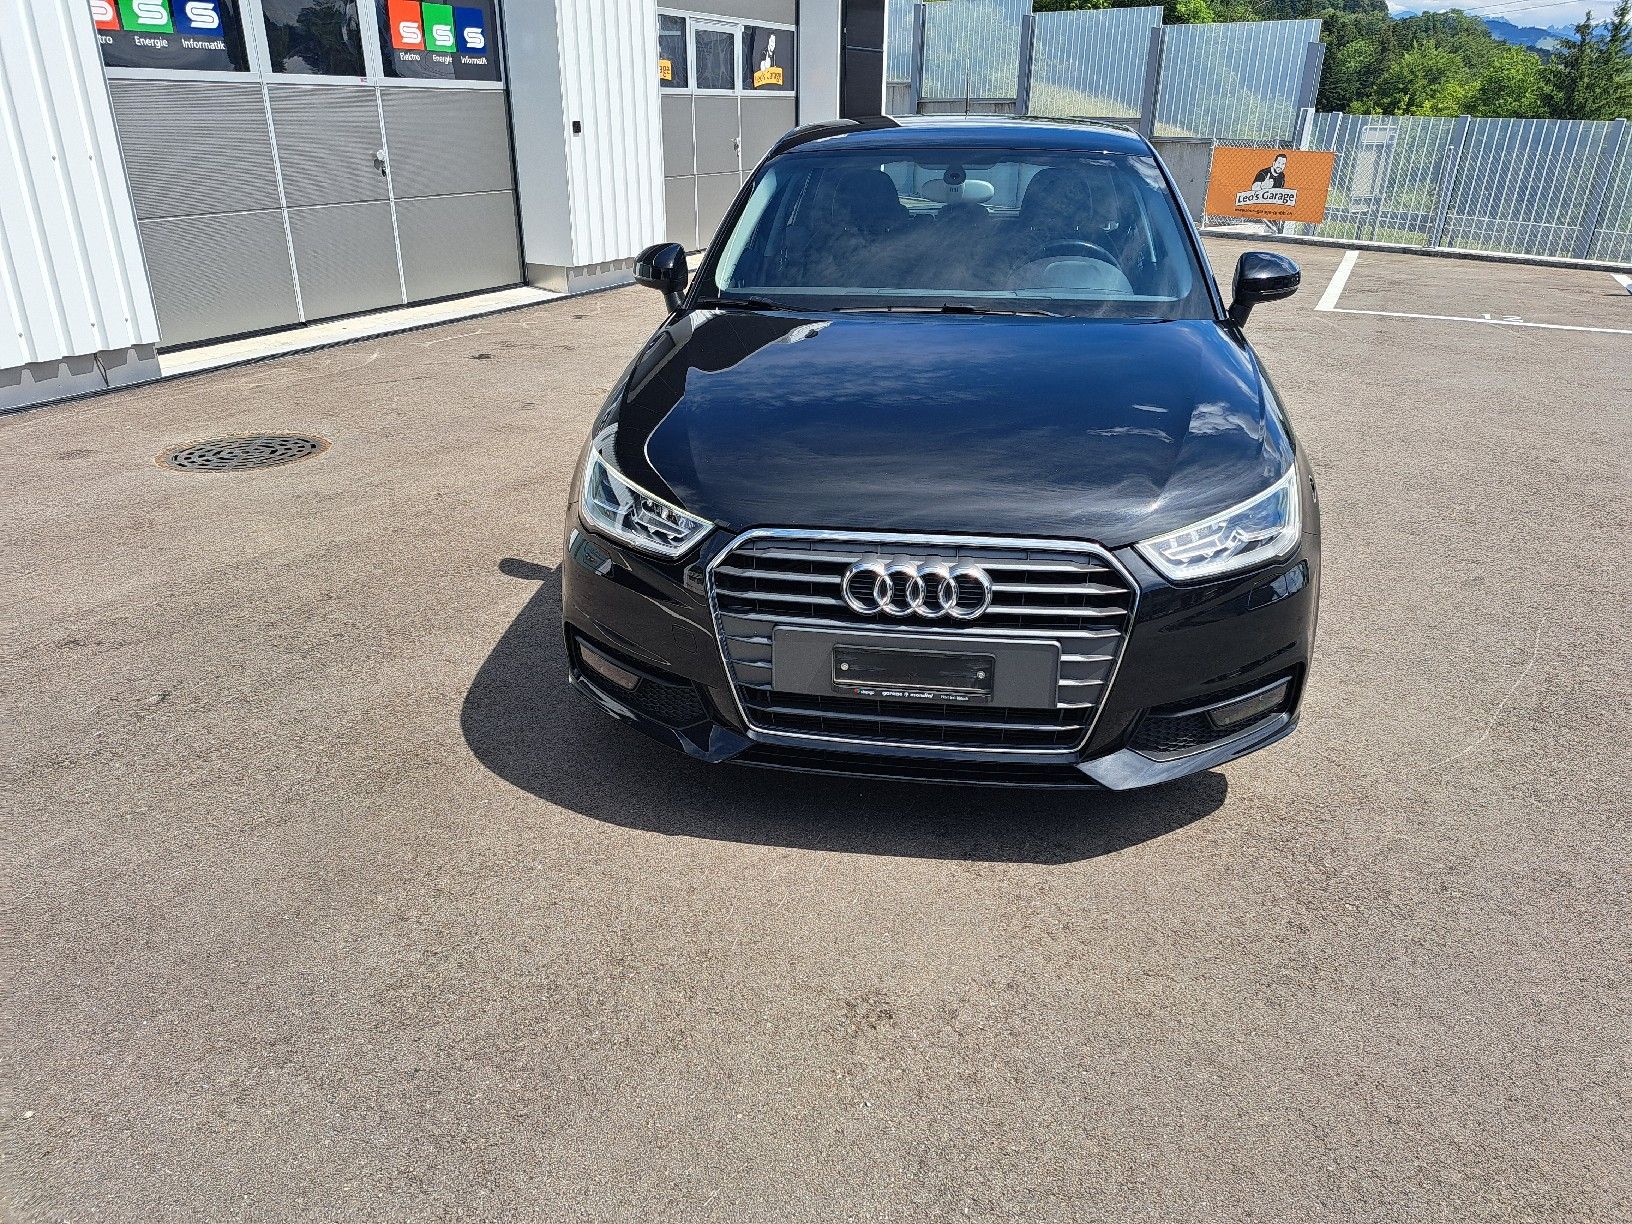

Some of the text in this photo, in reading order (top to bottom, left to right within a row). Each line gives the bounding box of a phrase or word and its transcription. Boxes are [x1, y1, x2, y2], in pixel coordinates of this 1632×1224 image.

[134, 36, 168, 49] Energie
[182, 37, 226, 50] Informatik
[399, 52, 488, 65] Elektro Energie Informatik
[1237, 190, 1295, 204] Leo's Garage
